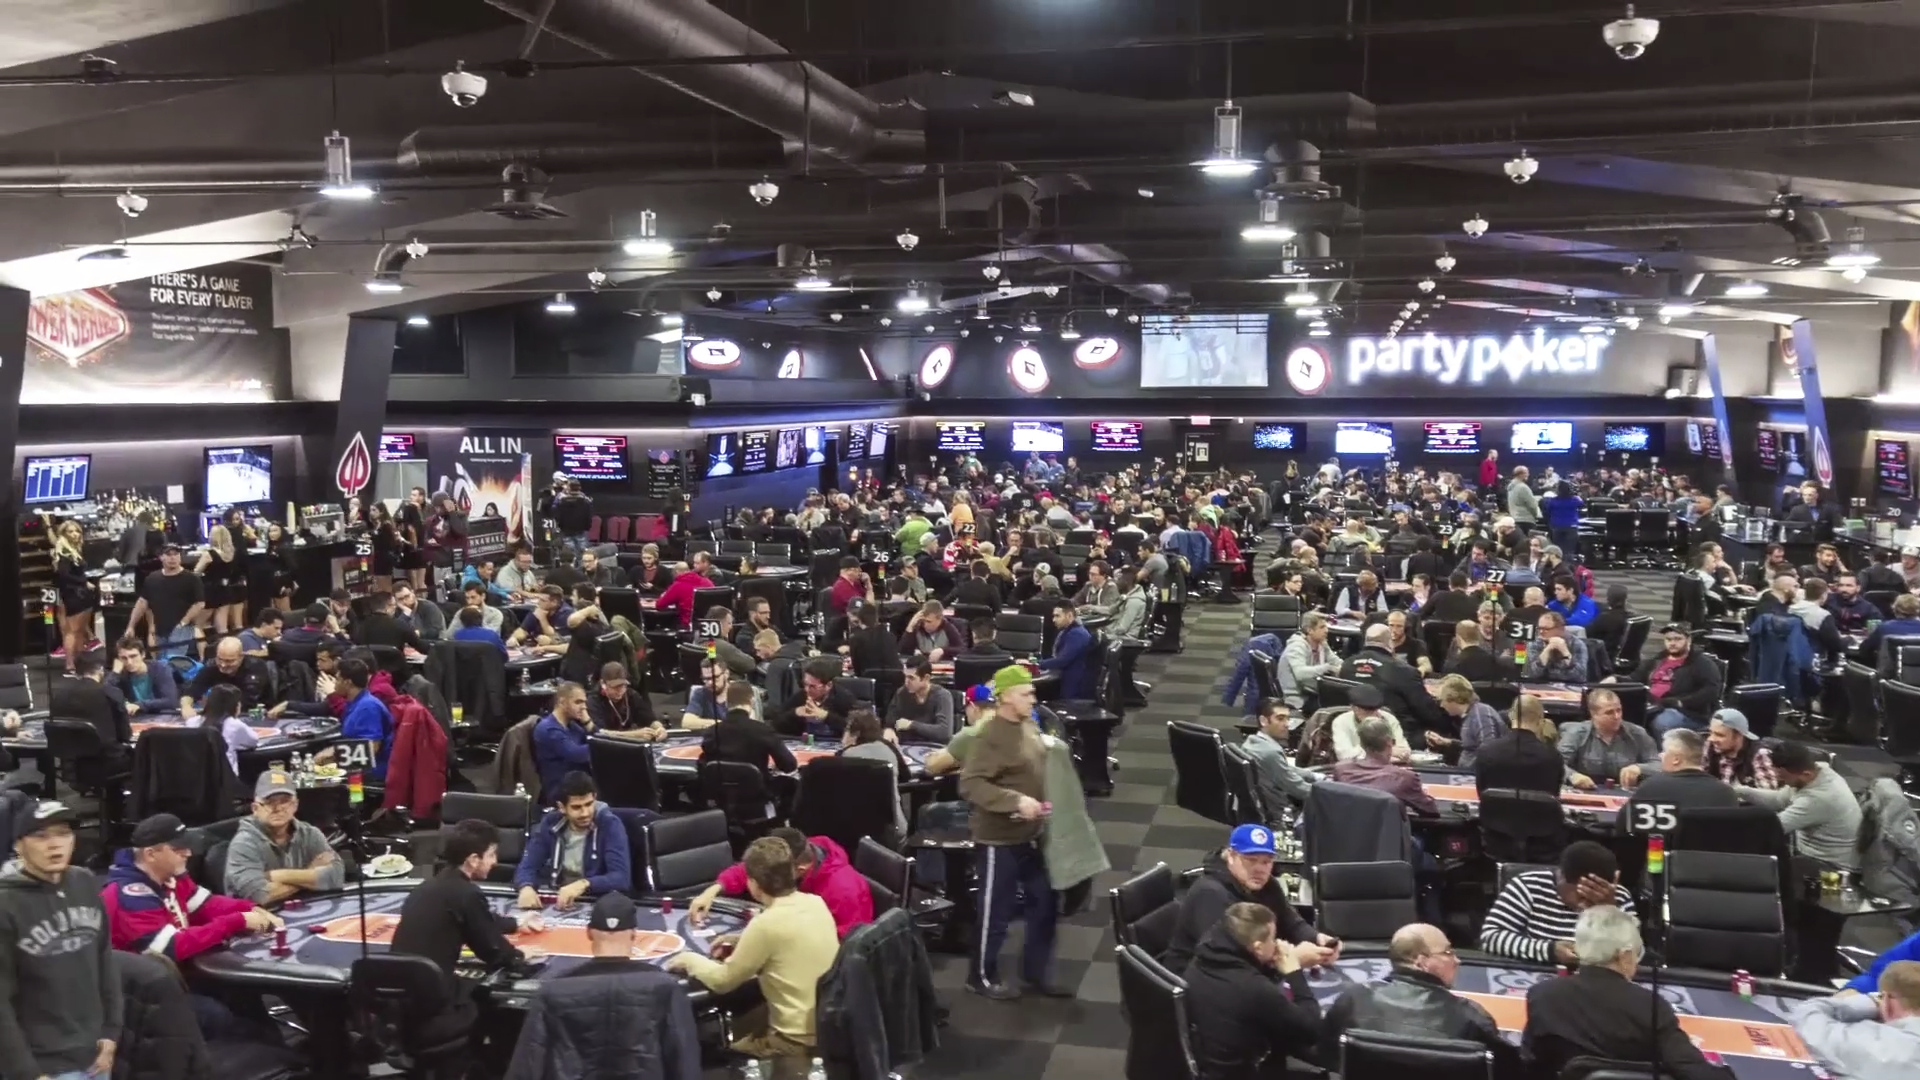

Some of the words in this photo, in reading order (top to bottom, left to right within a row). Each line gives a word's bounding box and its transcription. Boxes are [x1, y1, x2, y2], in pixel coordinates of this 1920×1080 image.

[151, 272, 198, 288] THERE'S
[200, 276, 208, 289] A
[209, 277, 240, 292] GAME
[150, 287, 175, 303] FOR
[177, 290, 212, 306] EVERY
[215, 293, 254, 310] PLAYER
[460, 436, 495, 453] ALL
[500, 437, 521, 453] IN
[1022, 499, 1031, 507] 18
[1431, 502, 1441, 510] 19
[1887, 507, 1901, 517] 20
[543, 519, 553, 528] 21
[963, 523, 976, 533] 22
[1439, 525, 1453, 534] 23
[355, 544, 371, 555] 25
[873, 551, 889, 562] 26
[1487, 570, 1505, 582] 27
[41, 588, 56, 603] 29
[700, 621, 720, 636] 30
[1510, 621, 1534, 639] 31
[337, 744, 369, 766] 34
[1634, 803, 1677, 830] 35
